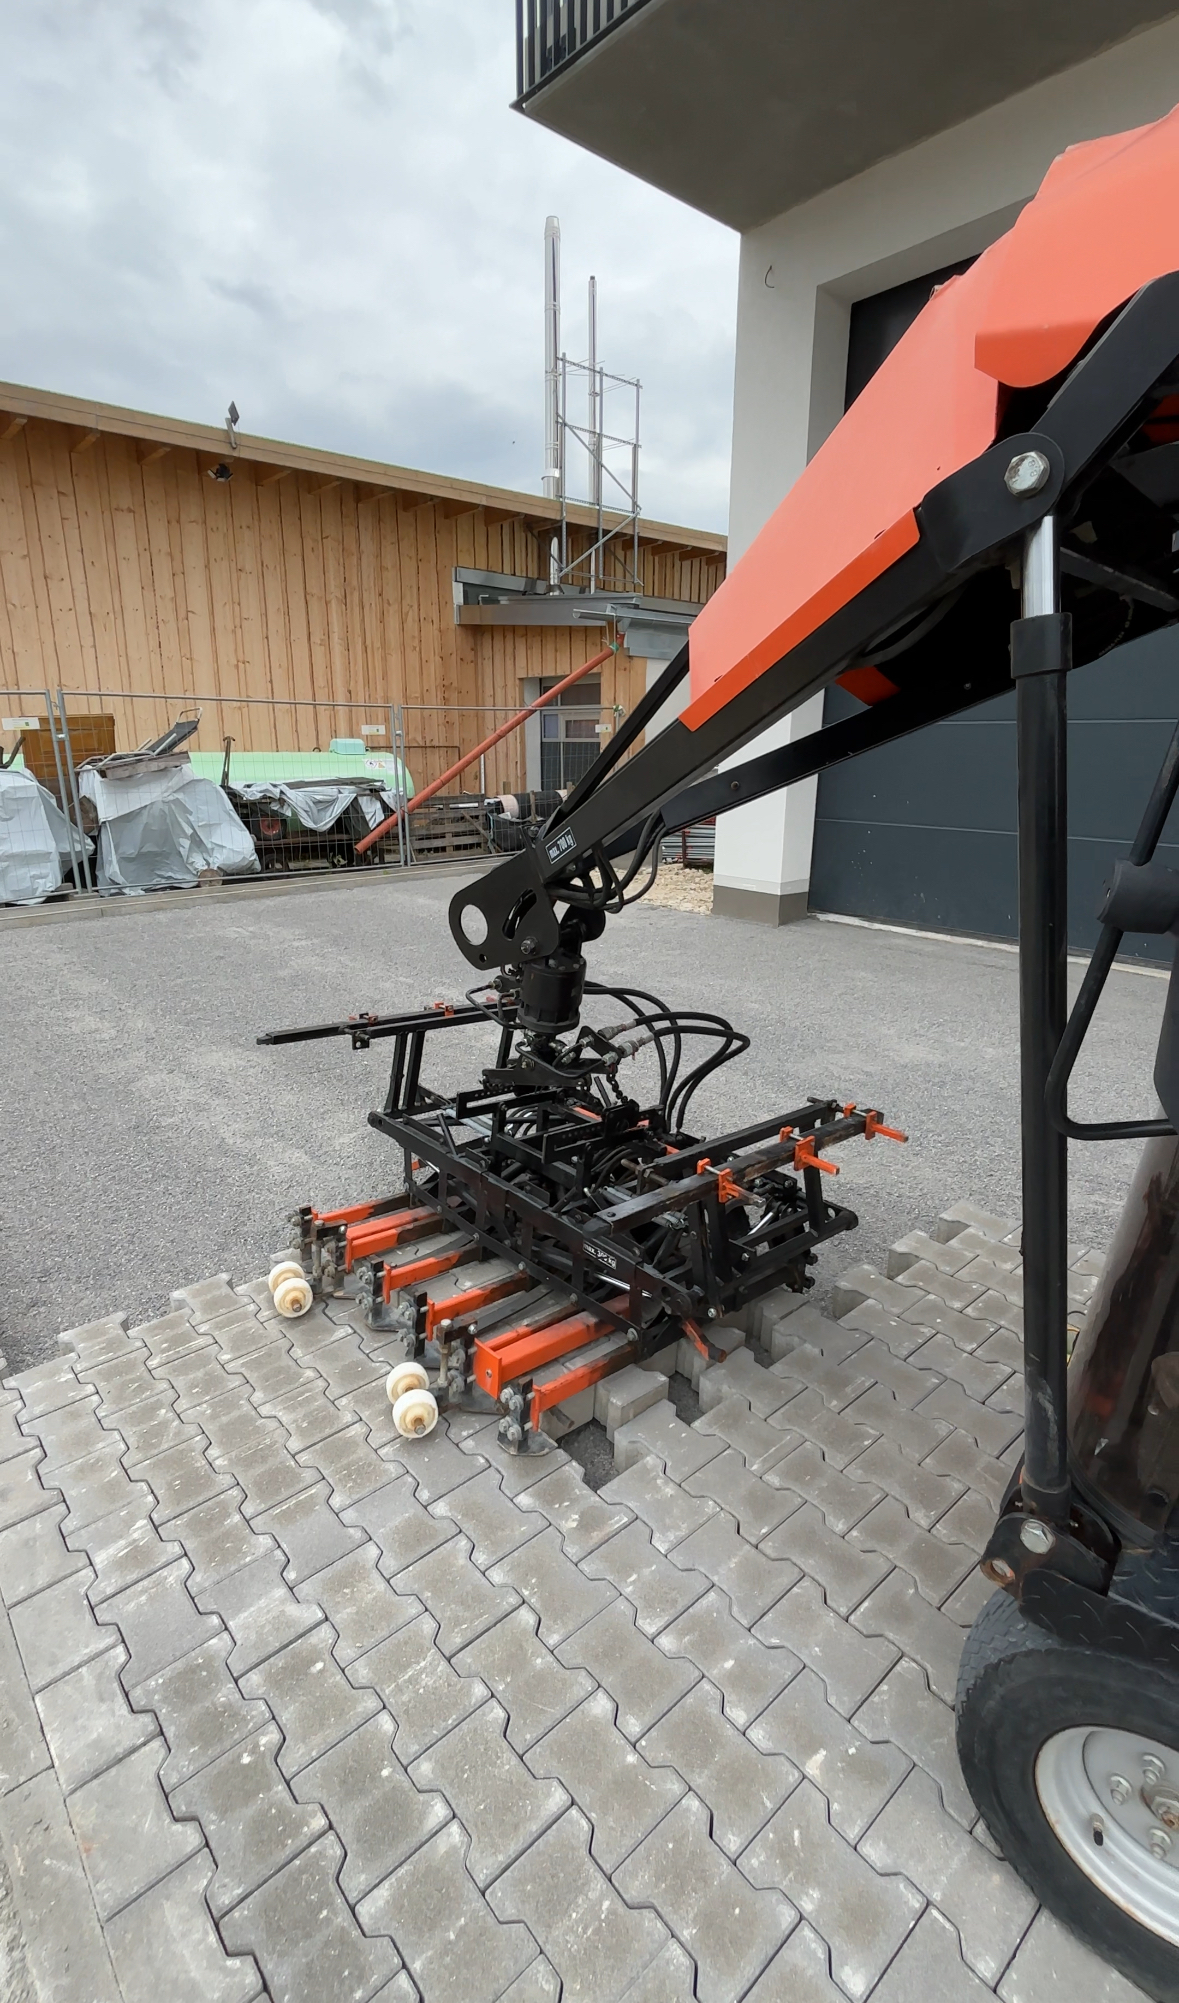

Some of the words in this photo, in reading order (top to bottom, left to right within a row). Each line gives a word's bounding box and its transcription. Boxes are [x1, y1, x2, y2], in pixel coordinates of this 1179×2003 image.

[549, 846, 560, 859] max.
[557, 836, 568, 852] 700
[565, 834, 574, 847] kg
[584, 1244, 596, 1255] max.
[608, 1257, 616, 1268] kg
